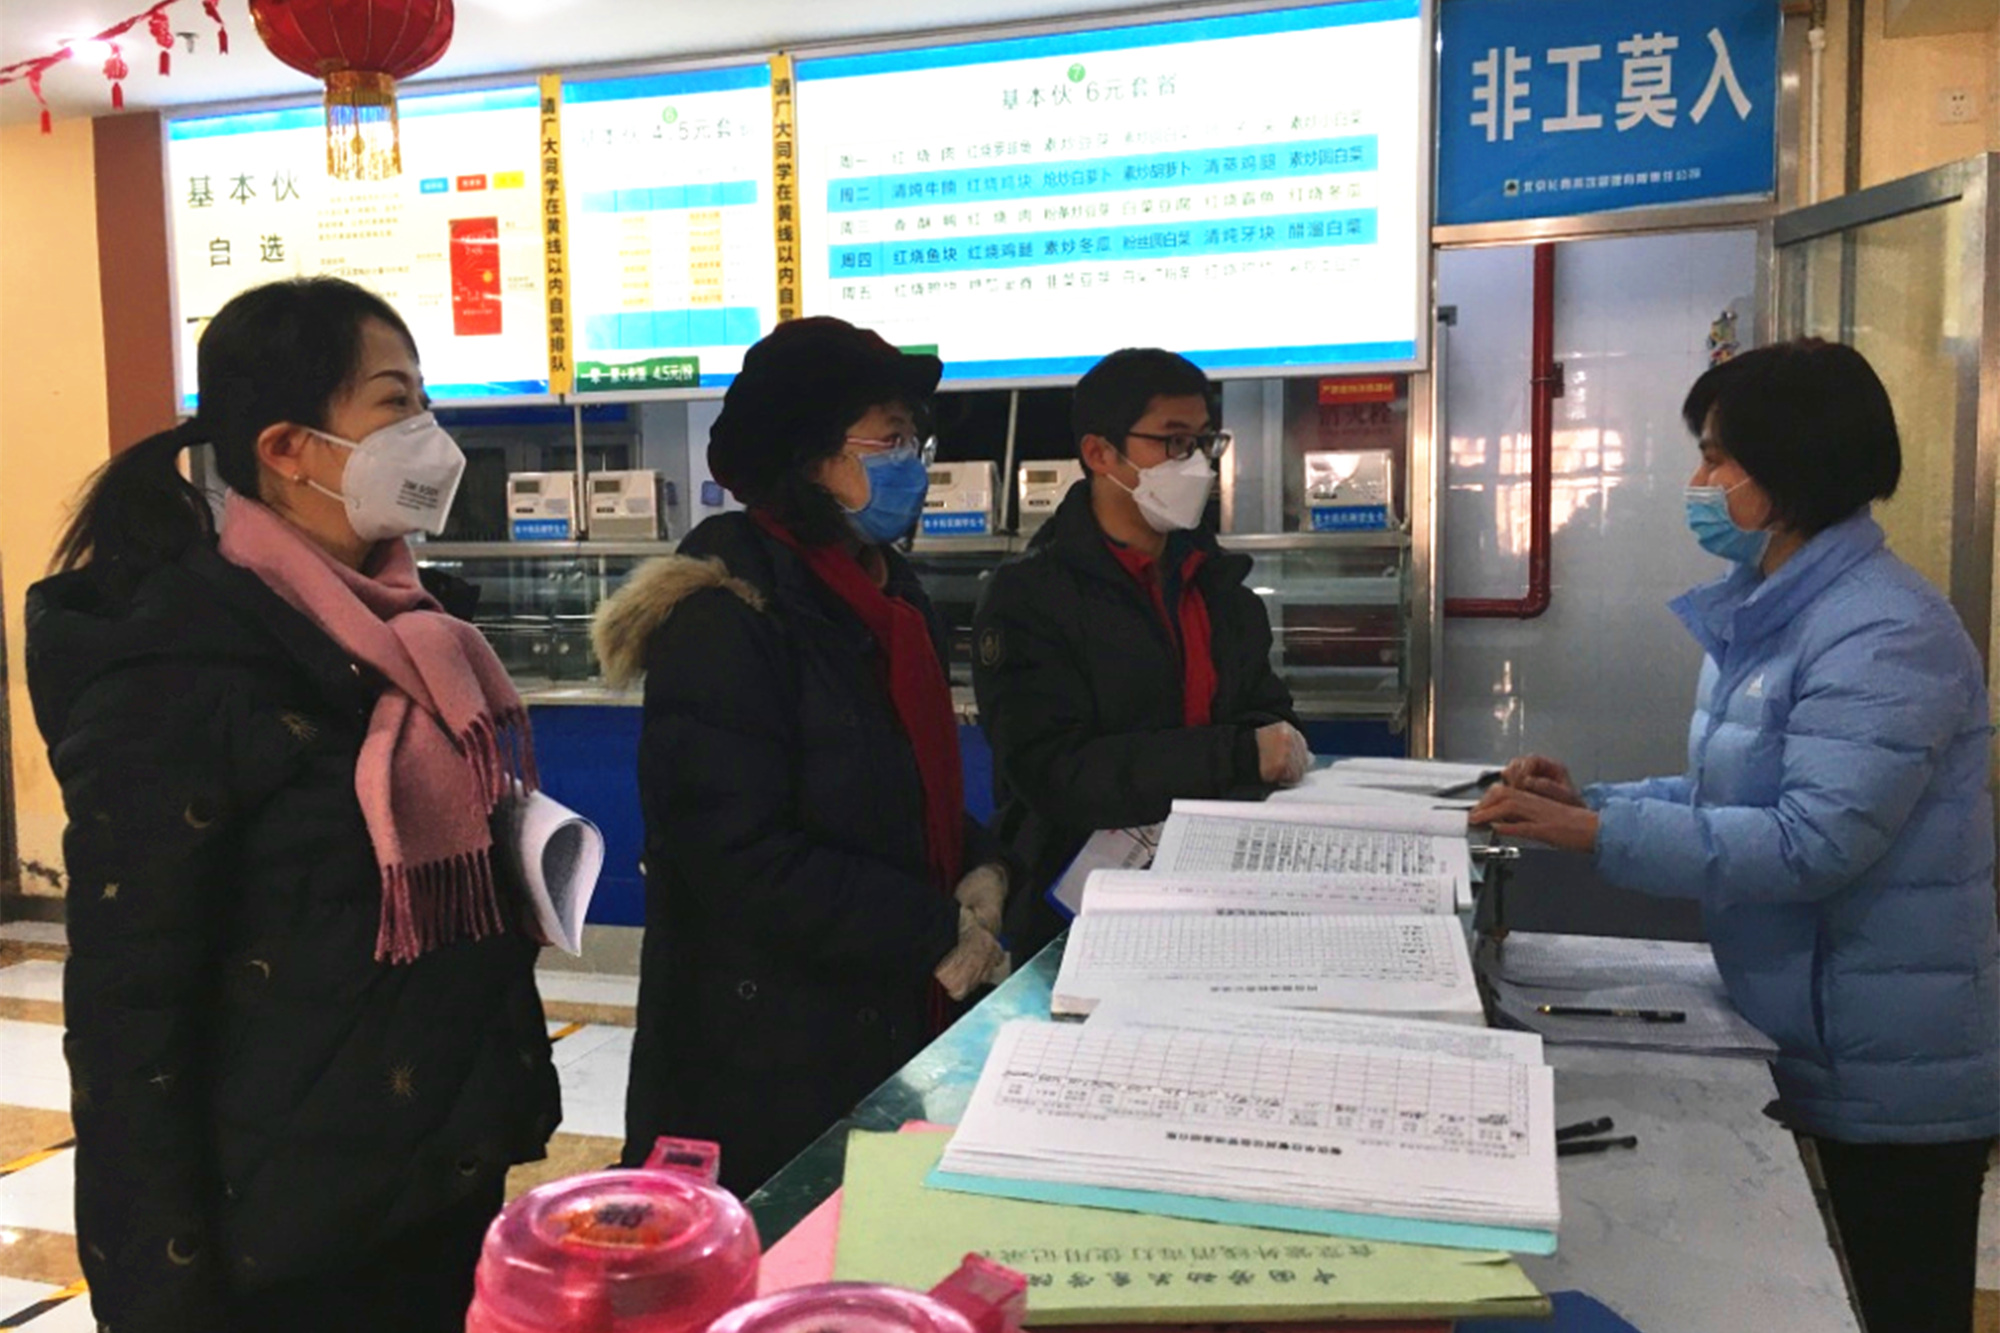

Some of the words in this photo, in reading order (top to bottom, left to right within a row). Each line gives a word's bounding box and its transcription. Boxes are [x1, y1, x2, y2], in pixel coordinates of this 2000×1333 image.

[1470, 27, 1752, 143] 非工莫入
[187, 169, 300, 208] 基本伙
[840, 186, 870, 203] 周二
[892, 180, 957, 199] 清炖牛腩
[1123, 161, 1191, 182] 素炒胡萝卜
[209, 233, 285, 267] 自选
[541, 97, 566, 372] 请广大同学在黄线以内自觉排队
[841, 252, 872, 269] 周四
[893, 247, 957, 266] 红烧鱼块
[968, 241, 1033, 261] 红烧鸡腿
[1044, 236, 1111, 256] 素炒冬瓜
